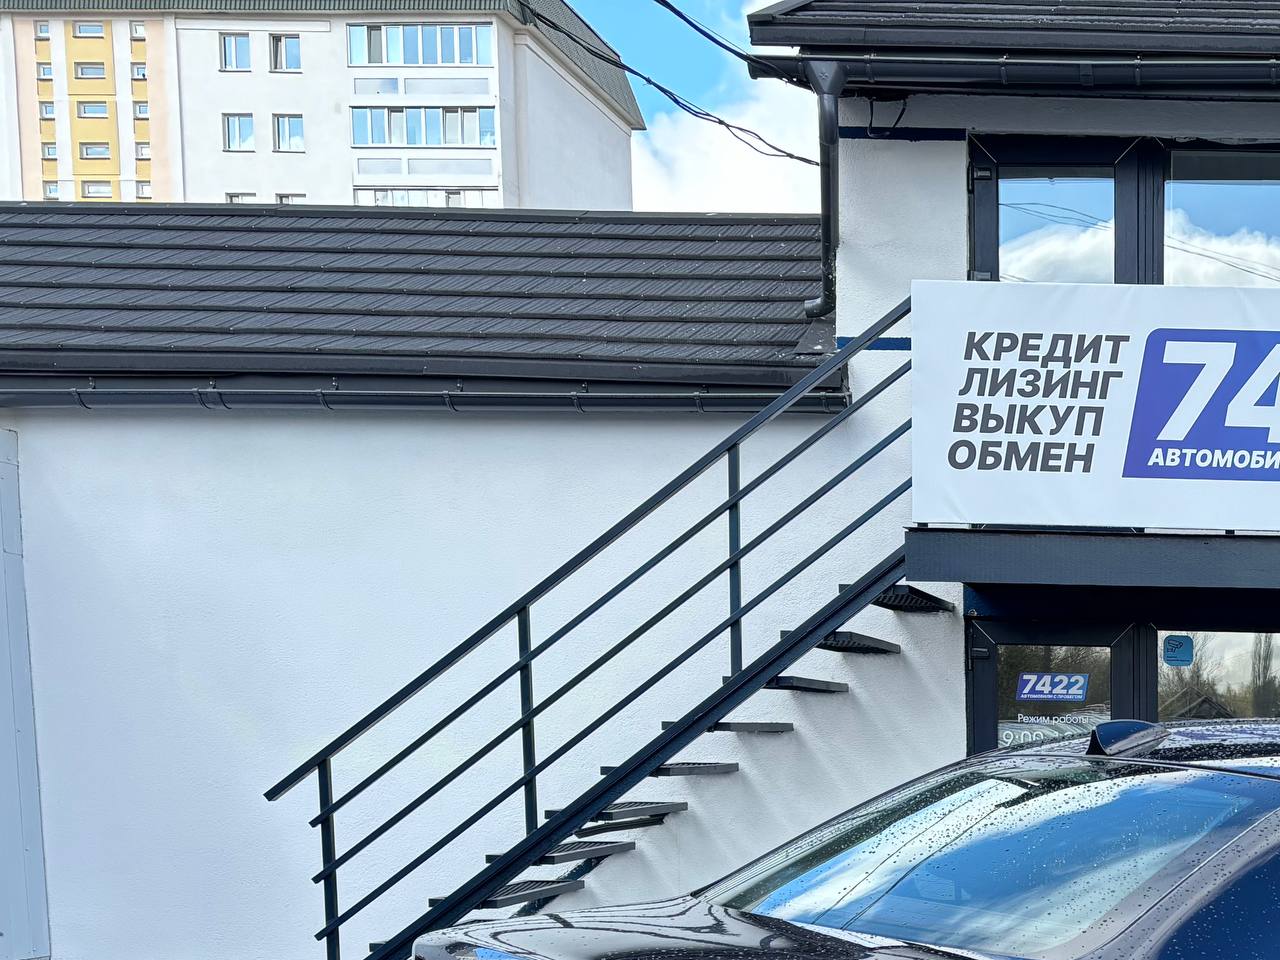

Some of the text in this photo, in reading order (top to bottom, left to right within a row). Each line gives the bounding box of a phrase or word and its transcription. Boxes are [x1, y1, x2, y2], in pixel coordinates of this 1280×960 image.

[964, 331, 1131, 369] КРЕДИТ
[958, 368, 1123, 400] ЛИЗИНГ
[952, 403, 1105, 436] ВЫКУП
[947, 439, 1095, 473] ОБМЕН
[1022, 674, 1085, 695] 7422
[1017, 713, 1089, 725] Режим работы
